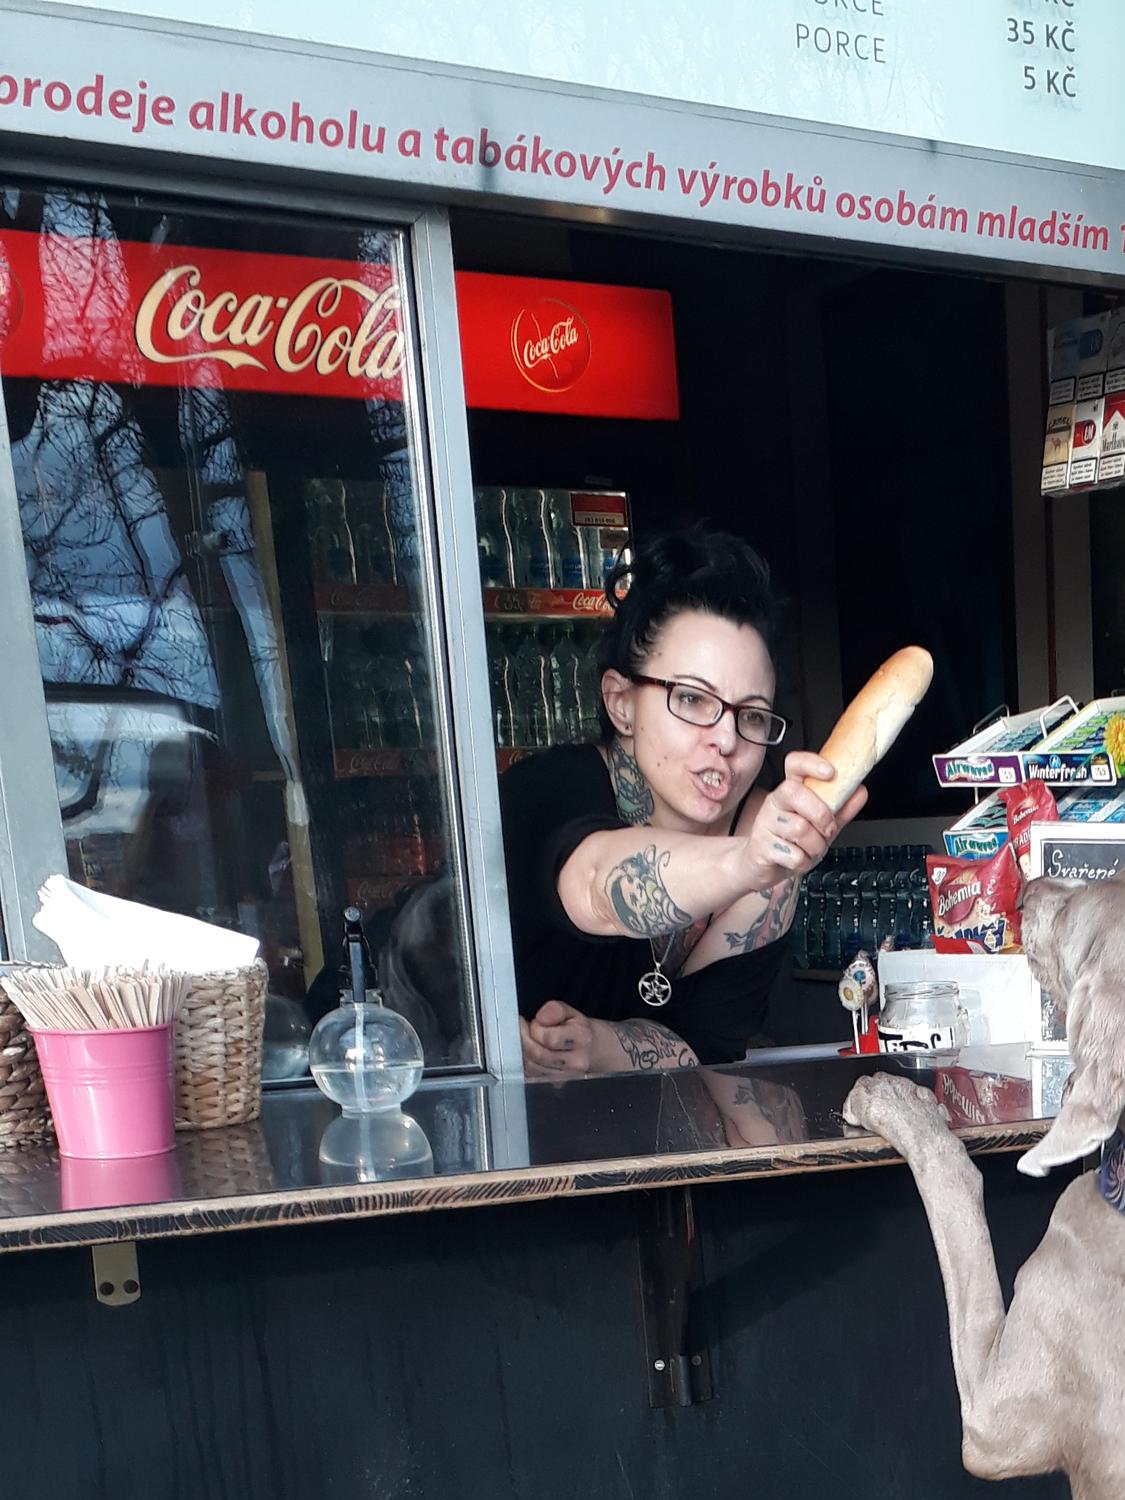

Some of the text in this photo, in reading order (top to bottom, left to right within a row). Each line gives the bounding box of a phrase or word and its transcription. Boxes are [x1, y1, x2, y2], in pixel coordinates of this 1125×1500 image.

[795, 23, 886, 64] PORCE
[1006, 17, 1076, 53] 35 KČ
[1023, 65, 1077, 98] 5 KČ
[188, 91, 386, 153] alkoholu
[398, 129, 422, 158] a
[434, 127, 666, 195] tabákových
[677, 161, 825, 214] výrobků
[836, 189, 967, 233] osobám
[977, 205, 1109, 251] mladším
[1047, 849, 1120, 880] Svařené
[938, 880, 982, 917] Bohemia
